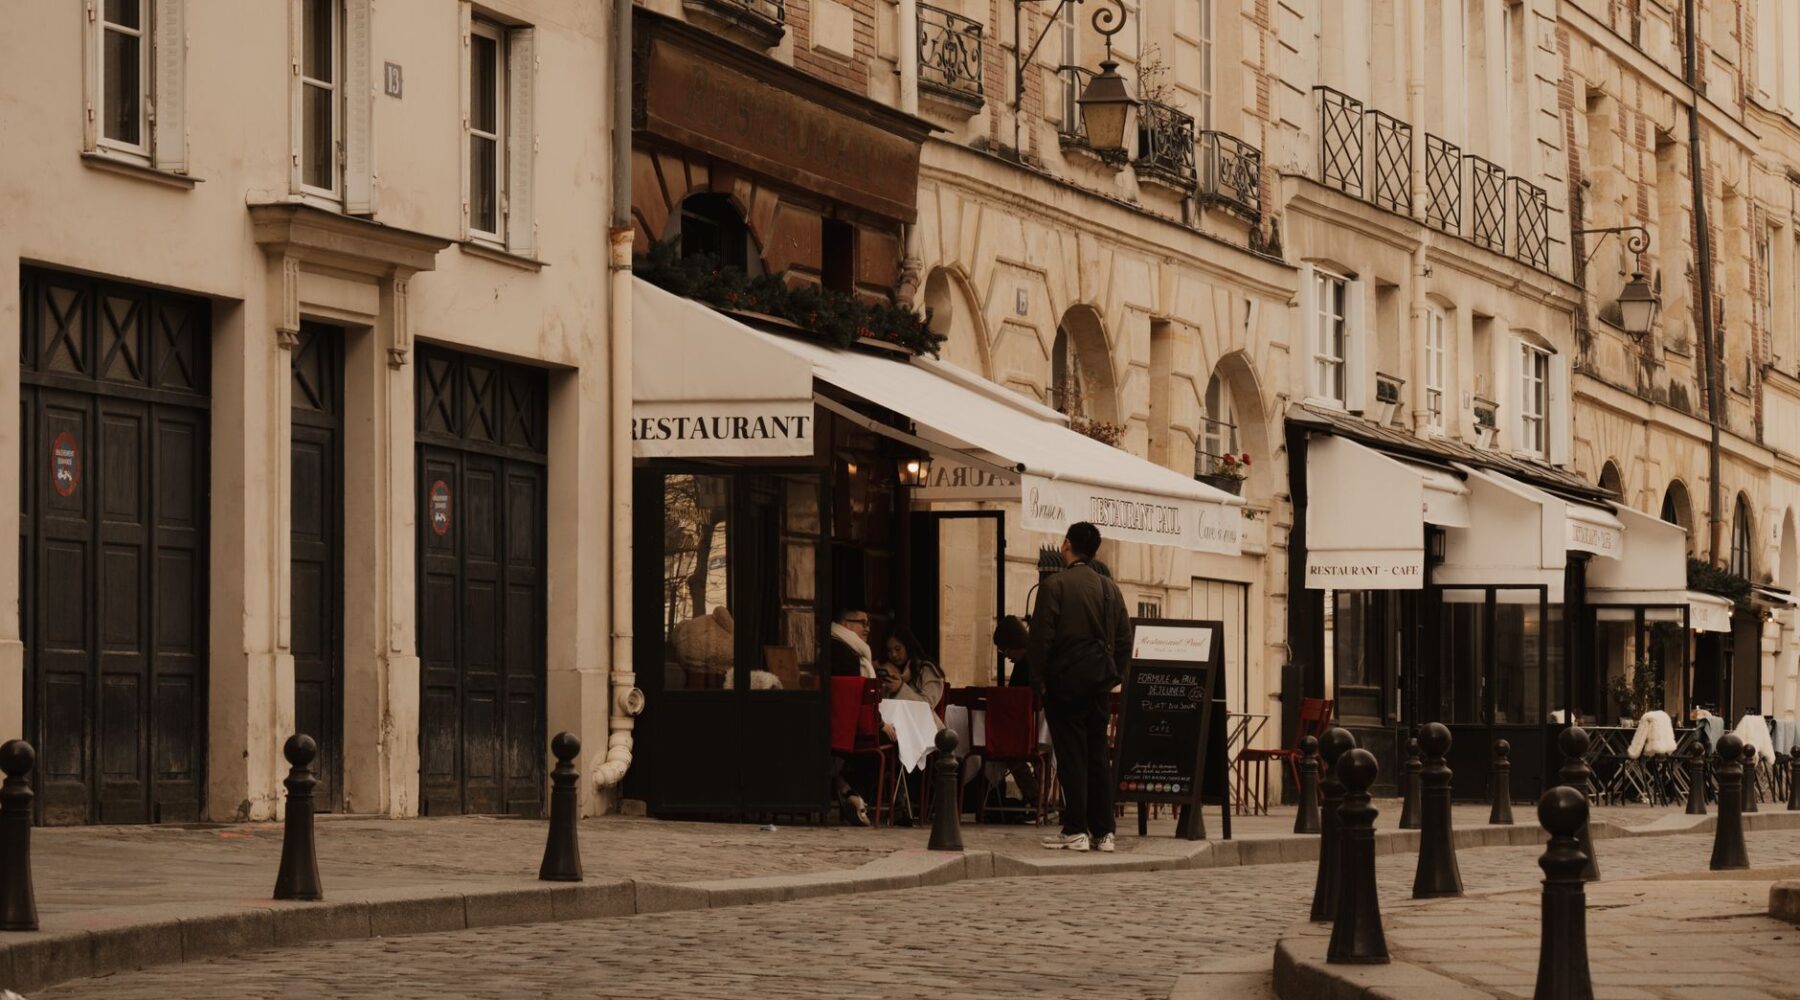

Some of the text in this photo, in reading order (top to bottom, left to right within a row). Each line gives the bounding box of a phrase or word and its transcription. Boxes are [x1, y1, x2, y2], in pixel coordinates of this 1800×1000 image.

[387, 66, 400, 94] 13
[1090, 496, 1154, 531] RESTAURANT
[1155, 505, 1182, 535] PAUL
[1310, 565, 1380, 575] RESTAURANT
